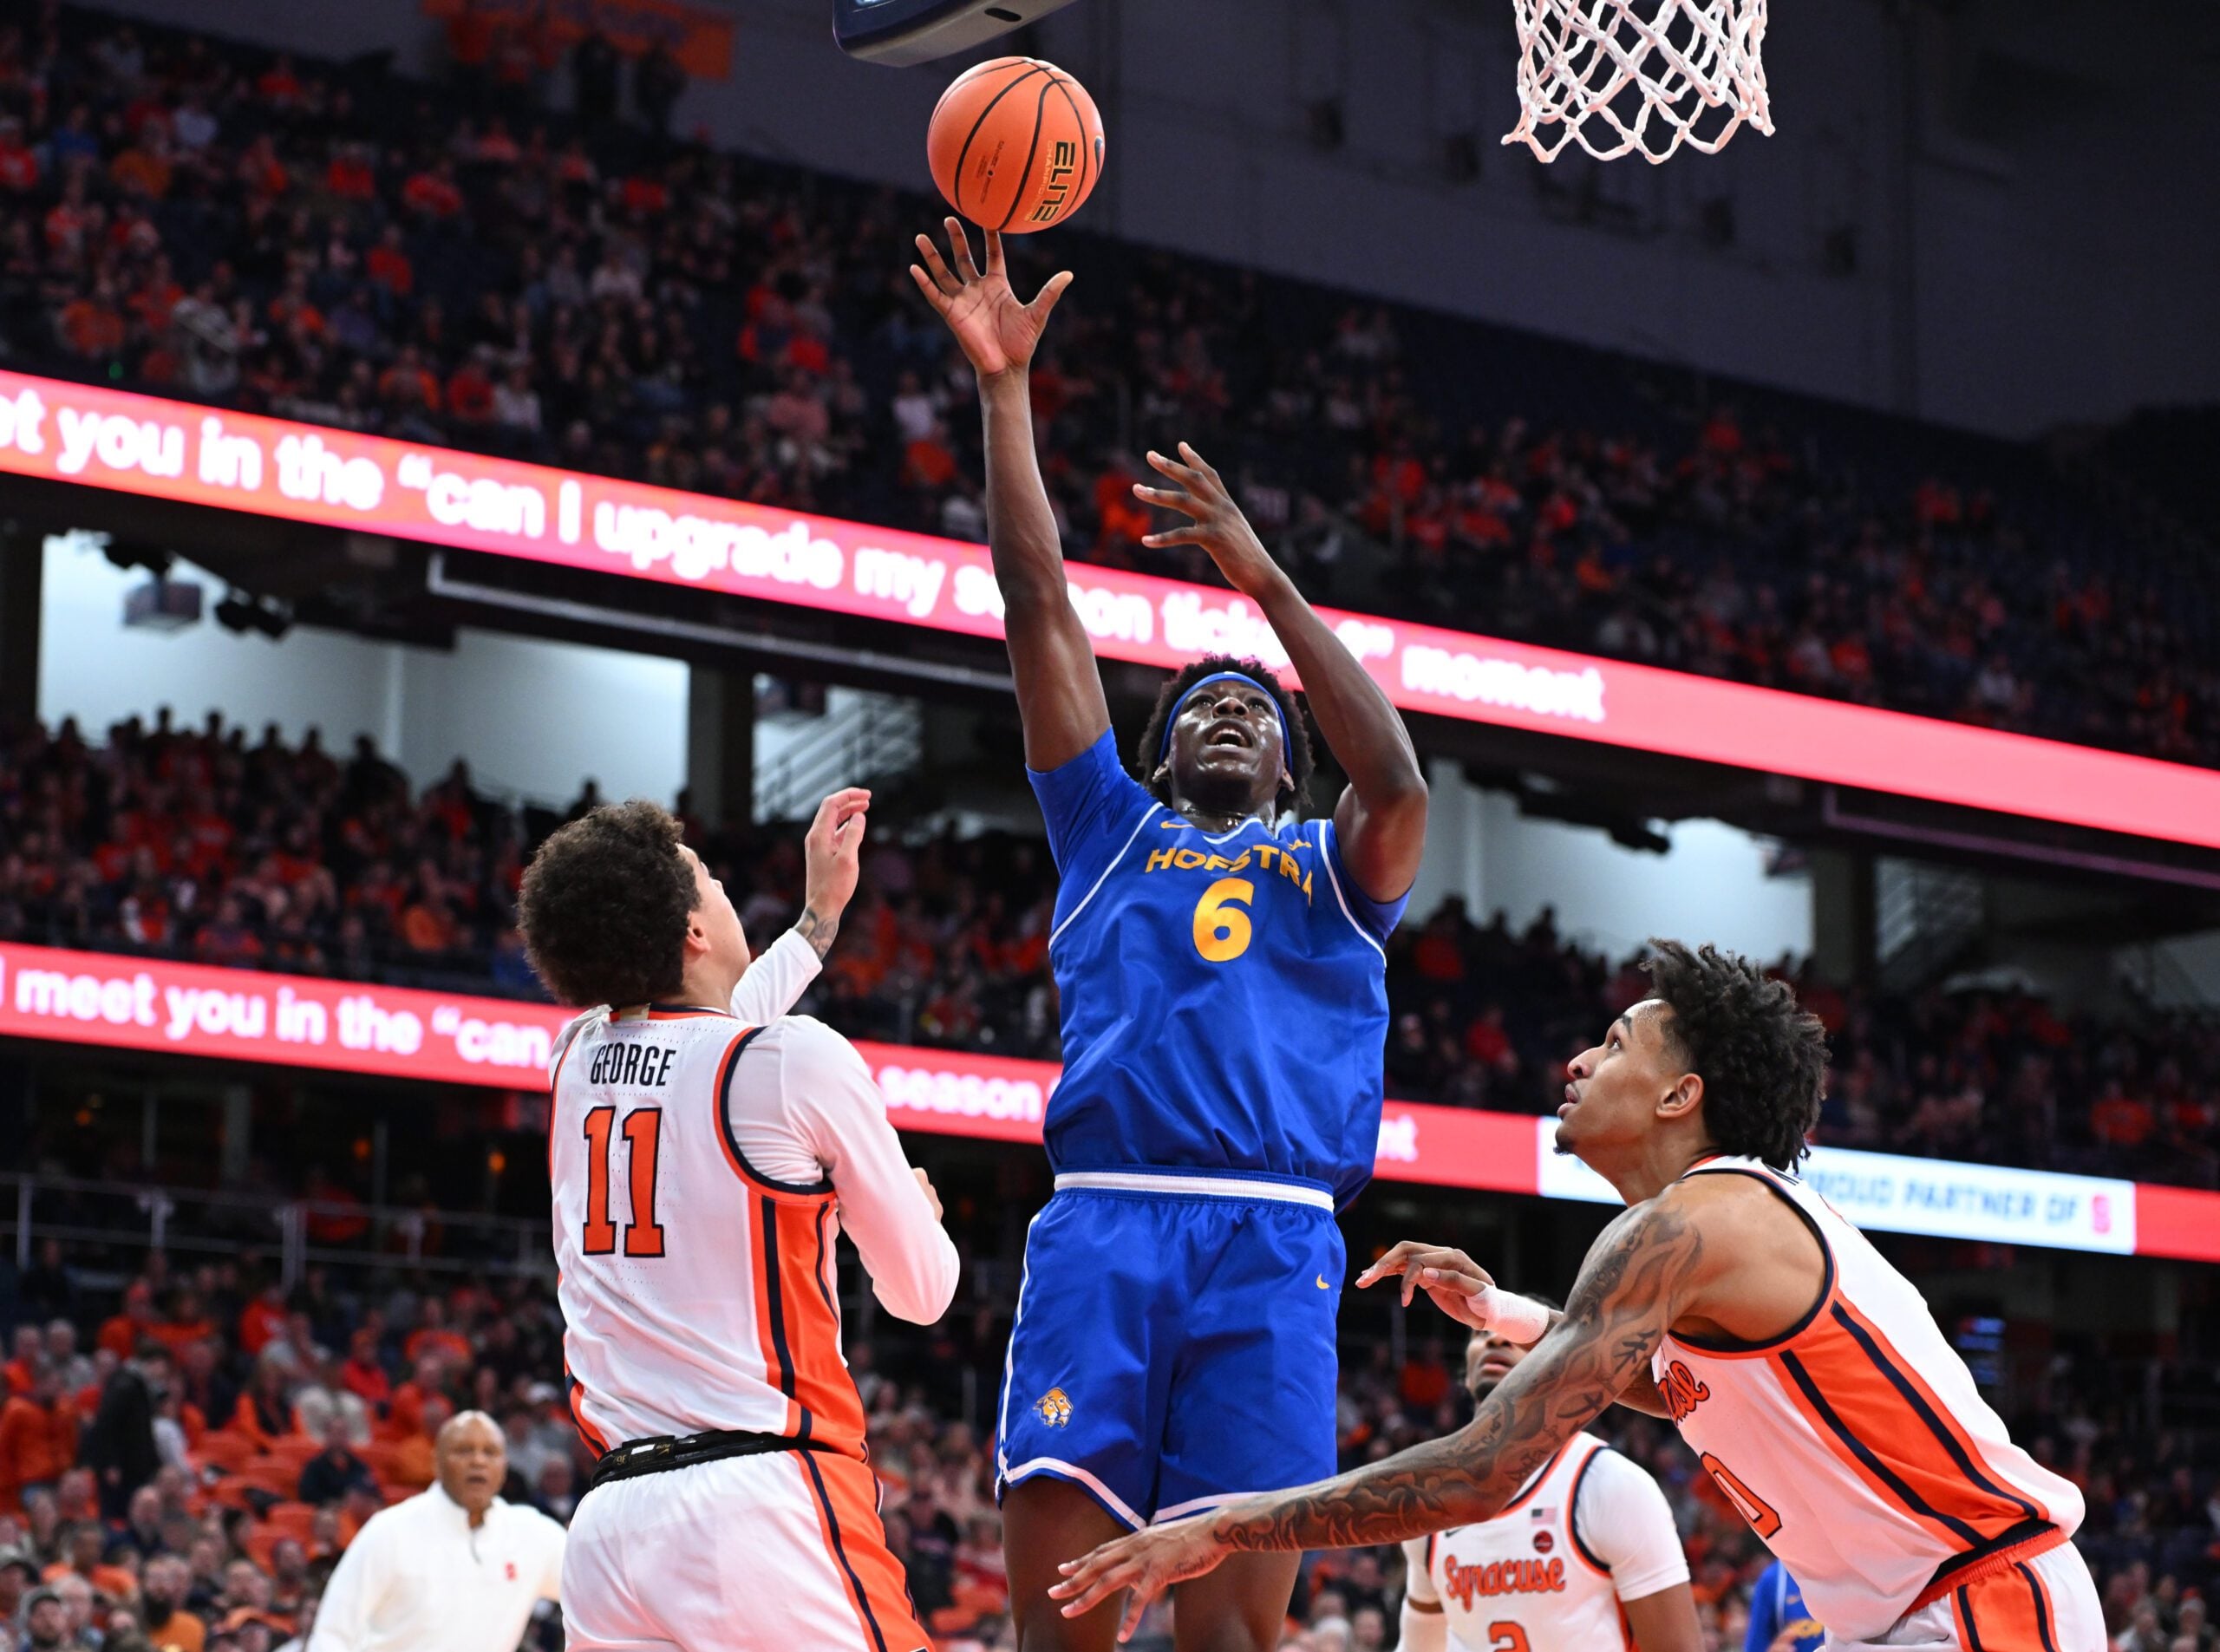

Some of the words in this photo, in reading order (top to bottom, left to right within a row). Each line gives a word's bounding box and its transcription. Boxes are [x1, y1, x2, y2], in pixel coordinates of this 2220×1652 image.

[1031, 141, 1075, 222] ELITE
[56, 407, 184, 474] you
[199, 416, 261, 490] in
[275, 434, 384, 511] the
[397, 453, 545, 539] “can
[558, 480, 581, 545] I
[594, 501, 844, 589] upgrade
[854, 547, 946, 618] my
[1401, 644, 1605, 724] moment
[1145, 845, 1313, 907] HOFSTRA
[1192, 878, 1255, 962] 6
[16, 969, 157, 1027] meet
[165, 985, 266, 1041] you
[275, 985, 327, 1044] in
[336, 995, 423, 1055] the
[878, 1066, 1042, 1123] season
[591, 1042, 676, 1086] GEORGE
[583, 1106, 665, 1257] 11
[1905, 1178, 2036, 1218] PARTNER
[2045, 1192, 2079, 1224] OF
[1444, 1554, 1565, 1613] Syracuse
